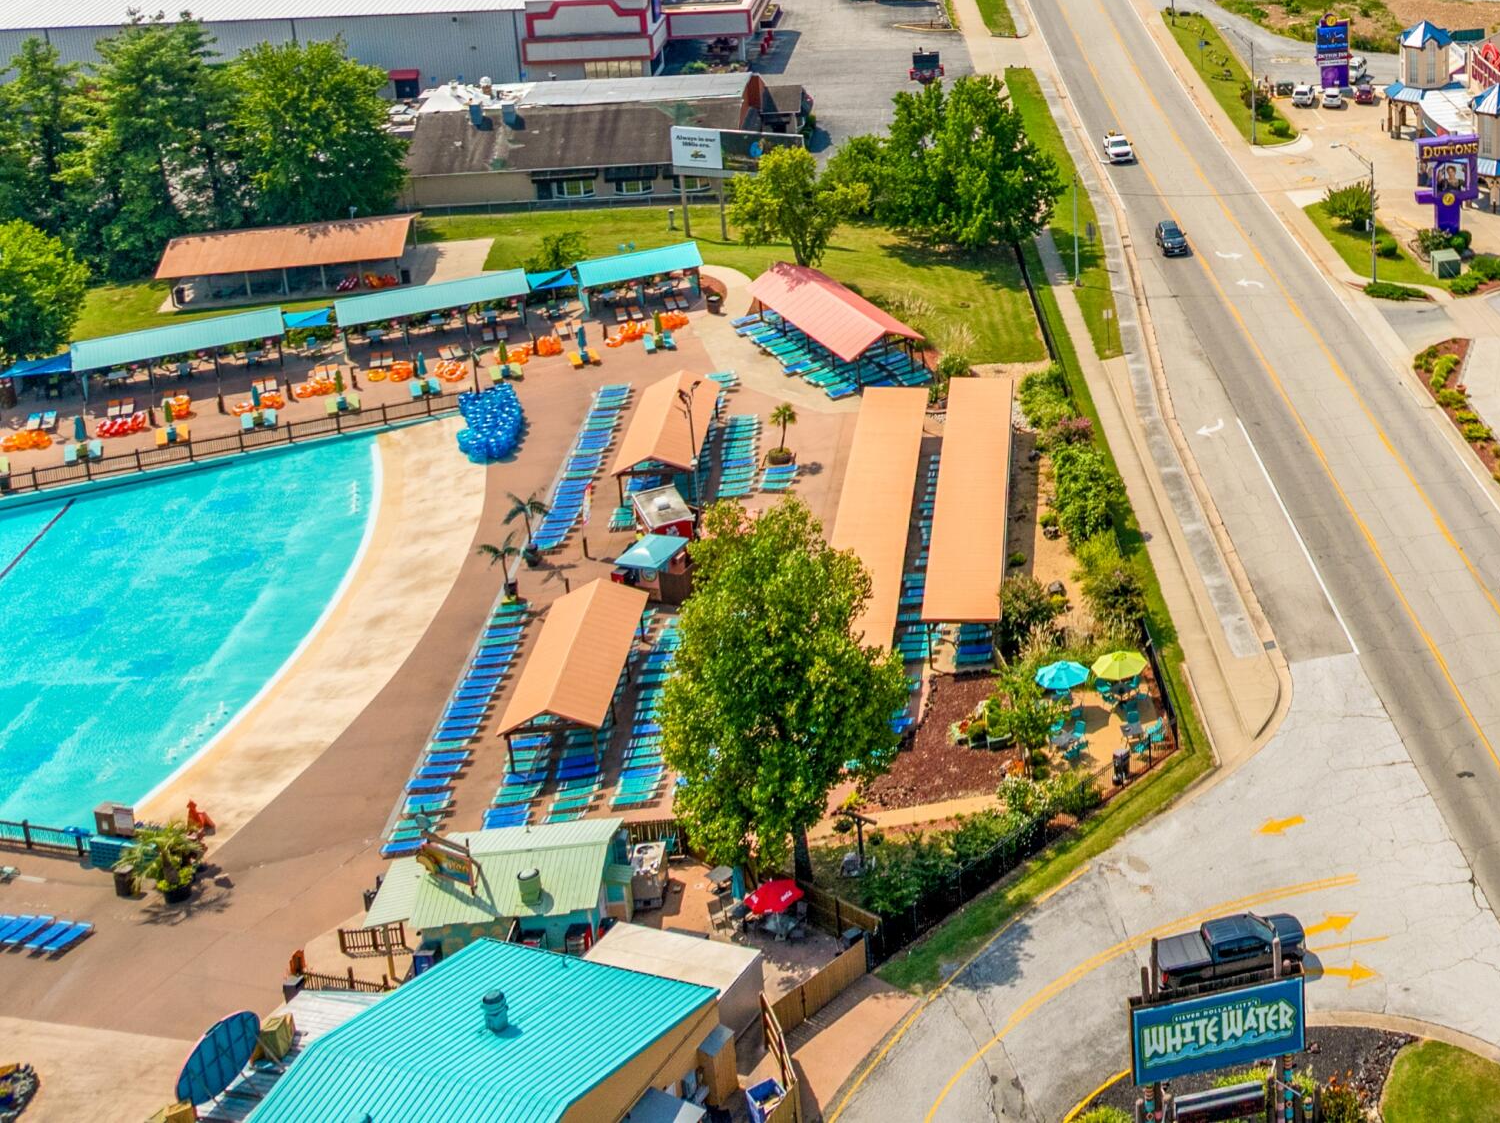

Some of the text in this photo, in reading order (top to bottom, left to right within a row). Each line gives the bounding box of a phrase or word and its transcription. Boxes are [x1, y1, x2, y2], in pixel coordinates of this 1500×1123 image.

[1423, 142, 1478, 158] DUTTONS
[1174, 1012, 1200, 1022] SILVER
[1203, 1004, 1233, 1016] DOLLAR
[1143, 1001, 1294, 1058] WHITE WATER
